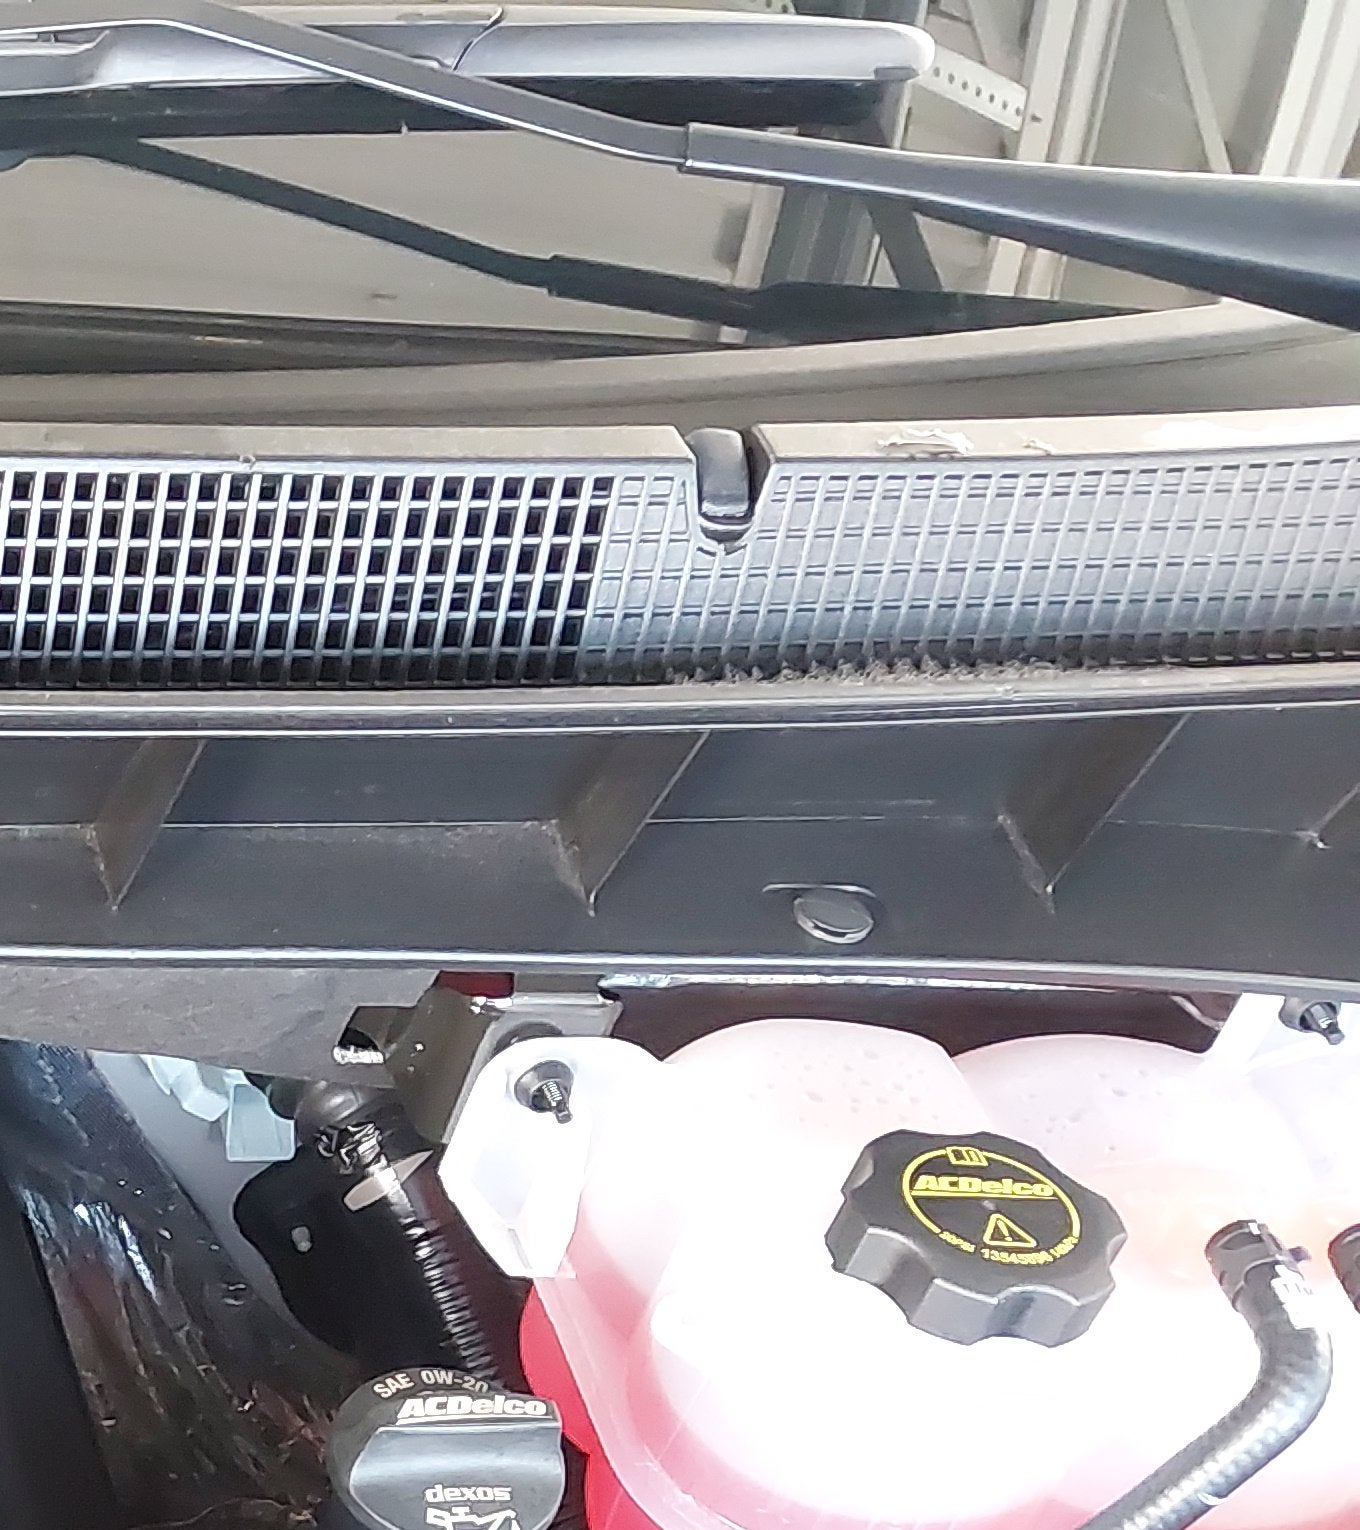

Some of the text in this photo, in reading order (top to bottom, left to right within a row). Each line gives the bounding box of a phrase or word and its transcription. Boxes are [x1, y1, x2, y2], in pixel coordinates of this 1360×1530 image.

[913, 1174, 1055, 1197] ACDelco
[373, 1369, 489, 1399] SAE 0W-20
[397, 1395, 547, 1419] ACDelco
[425, 1484, 512, 1502] dexos
